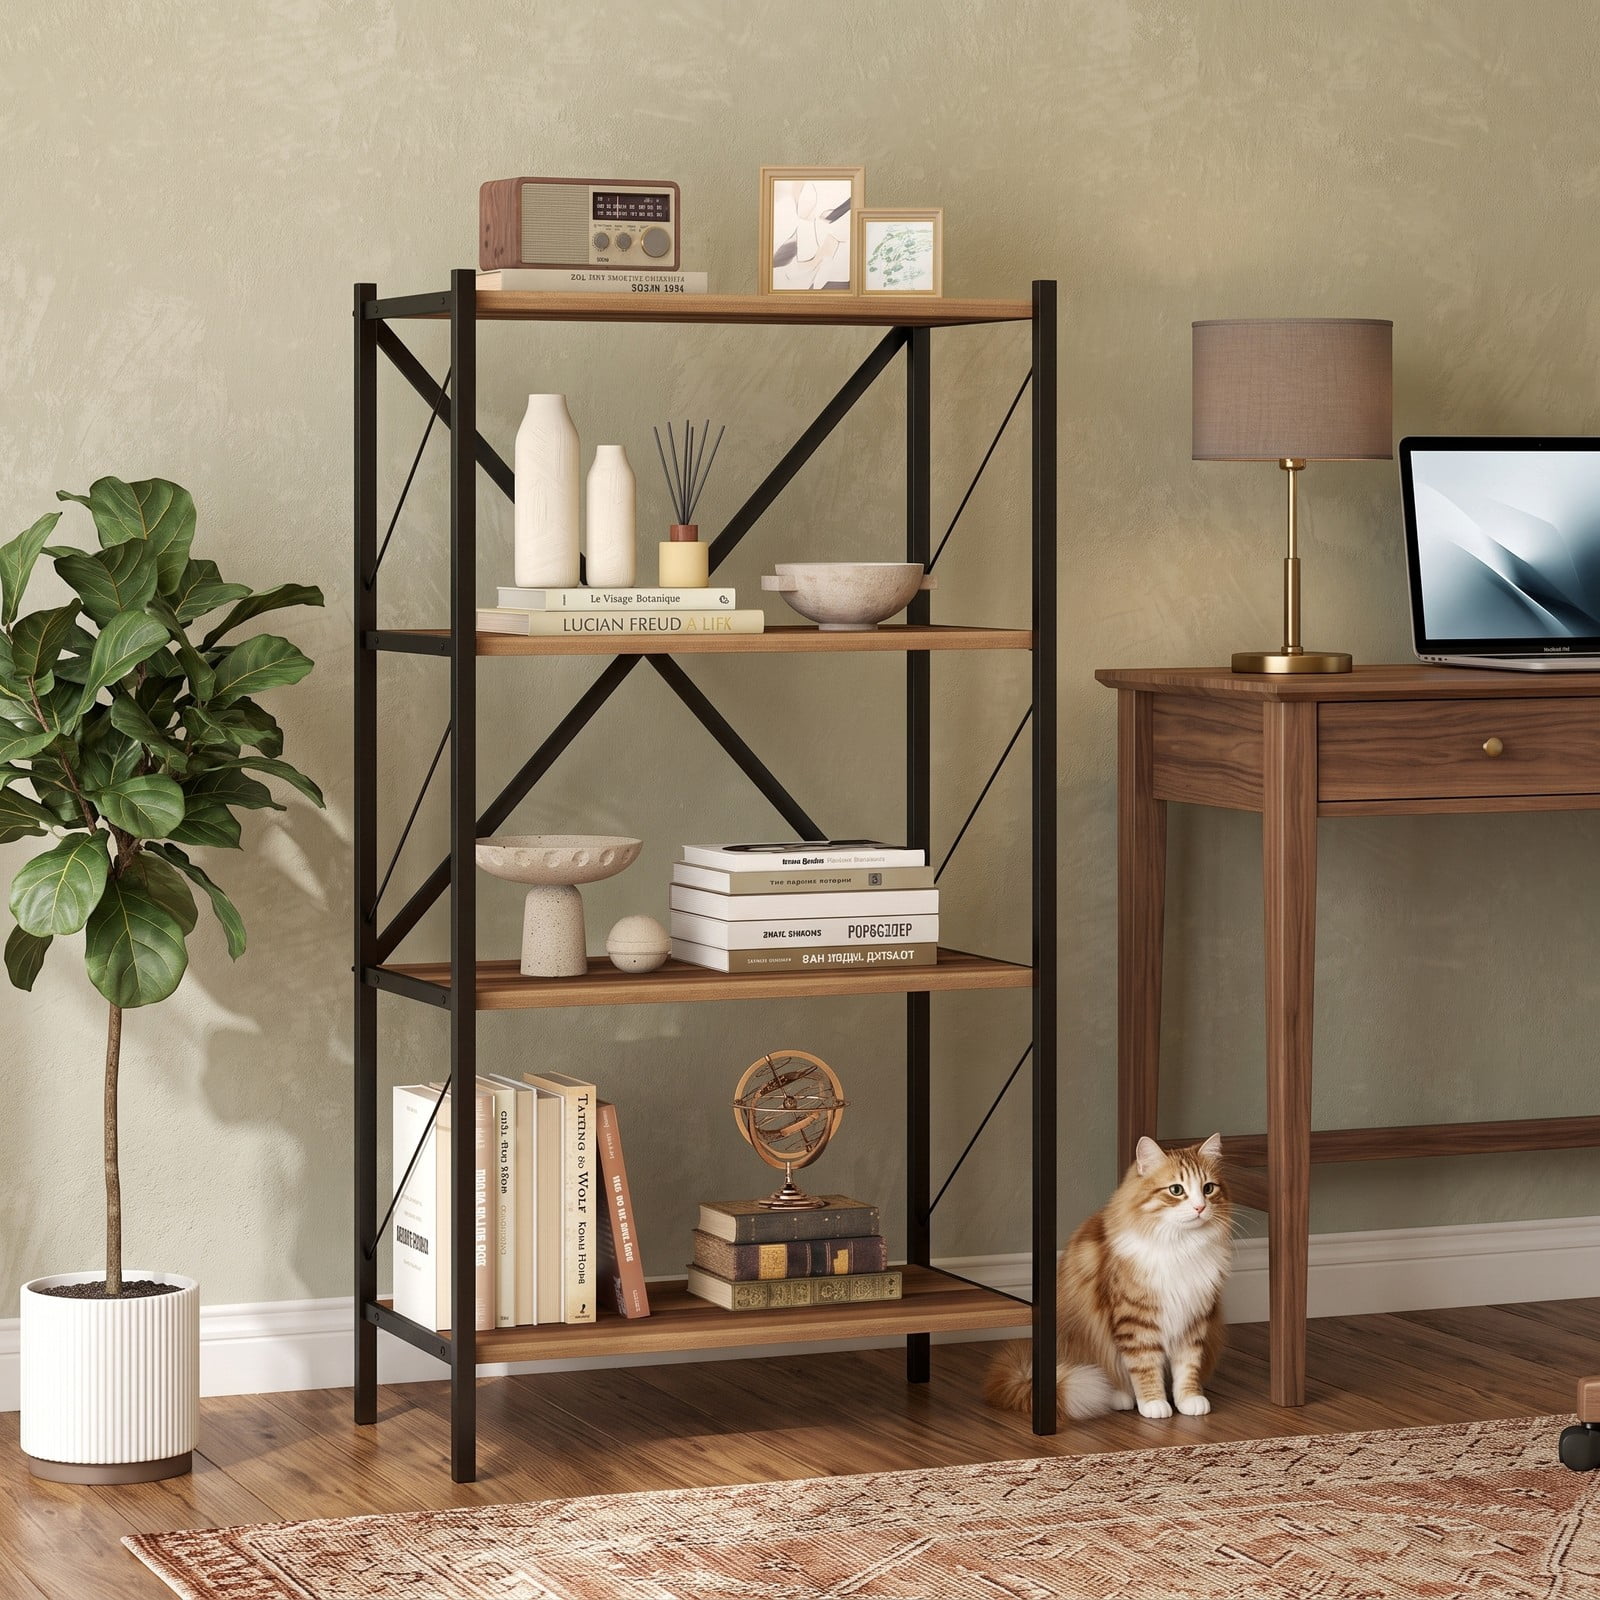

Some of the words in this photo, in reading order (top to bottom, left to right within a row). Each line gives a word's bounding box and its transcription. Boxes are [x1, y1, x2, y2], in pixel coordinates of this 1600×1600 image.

[590, 594, 601, 603] Le
[603, 594, 633, 605] Visage
[636, 594, 681, 605] Botanique
[563, 617, 624, 632] LUCIAN
[630, 617, 682, 632] FREUD
[686, 617, 697, 631] A
